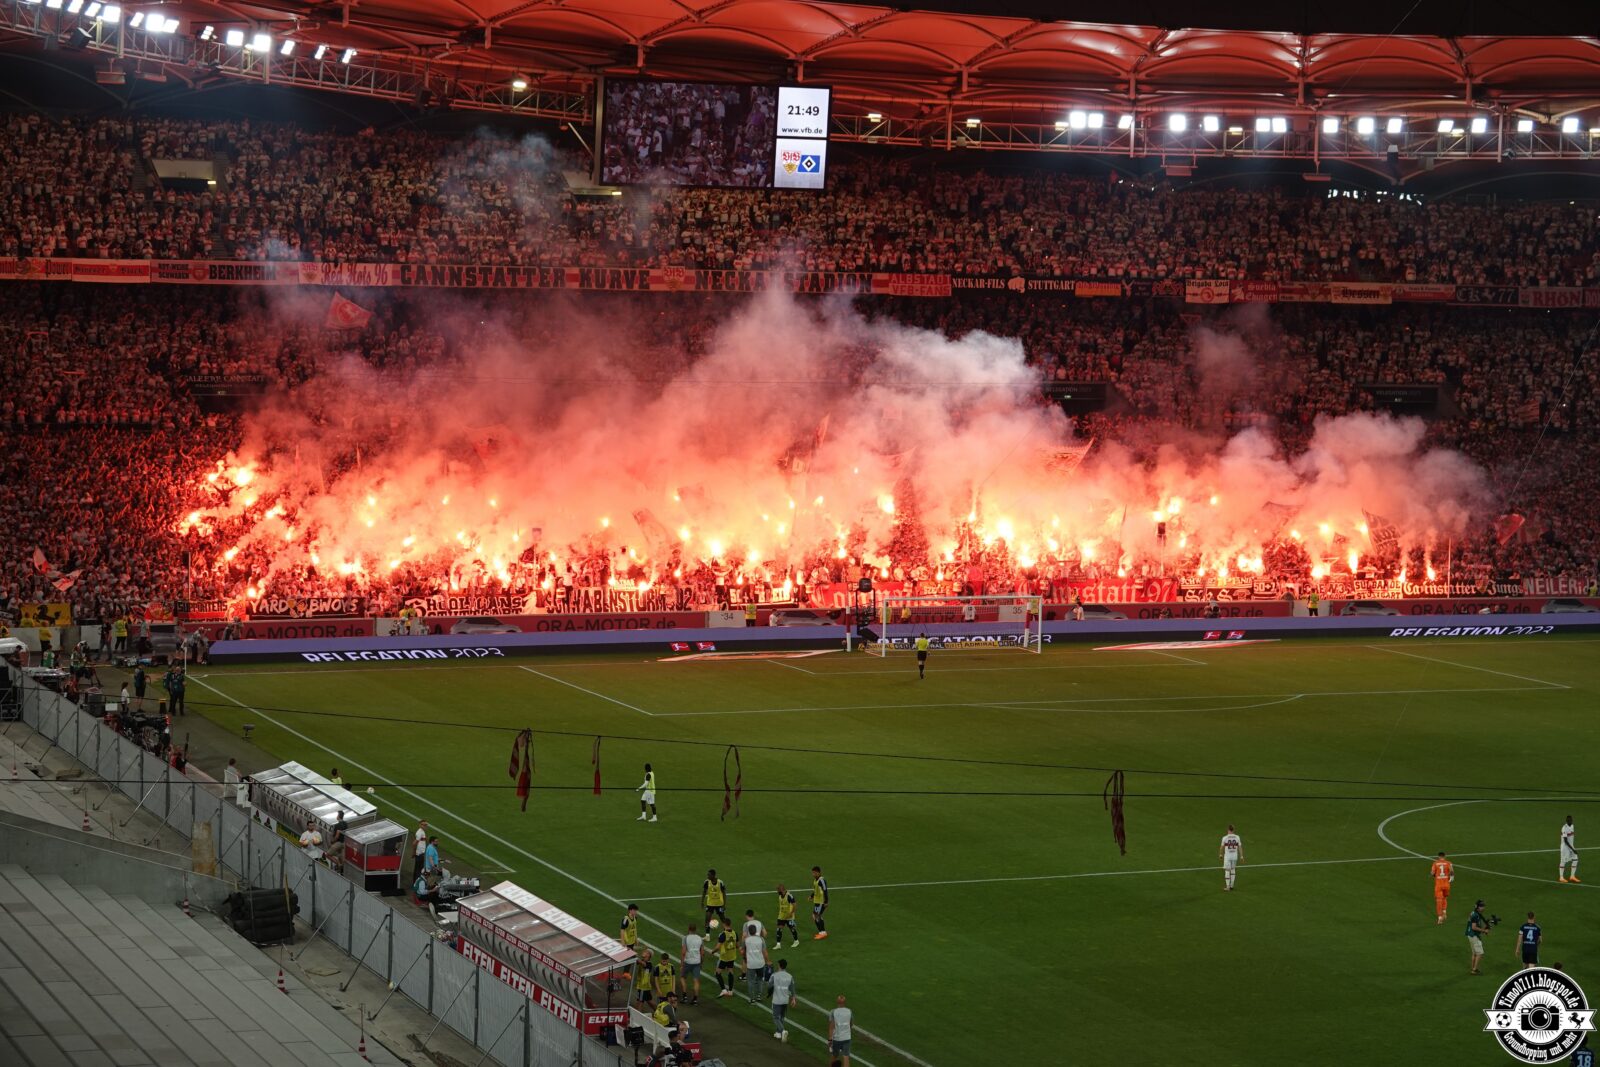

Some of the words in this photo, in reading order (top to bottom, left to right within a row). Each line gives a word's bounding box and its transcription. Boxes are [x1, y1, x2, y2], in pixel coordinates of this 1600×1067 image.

[788, 105, 819, 116] 21:49
[209, 264, 276, 281] BERKHEIM
[401, 265, 565, 287] CANNSTATTER
[580, 267, 650, 290] KURVE
[1028, 279, 1074, 291] STUTTGART
[251, 599, 288, 614] YARD
[463, 940, 495, 976] ELTEN
[500, 965, 535, 1001] ELTEN
[540, 989, 578, 1028] ELTEN
[588, 1015, 624, 1025] ELTEN
[1577, 1054, 1592, 1067] 18
